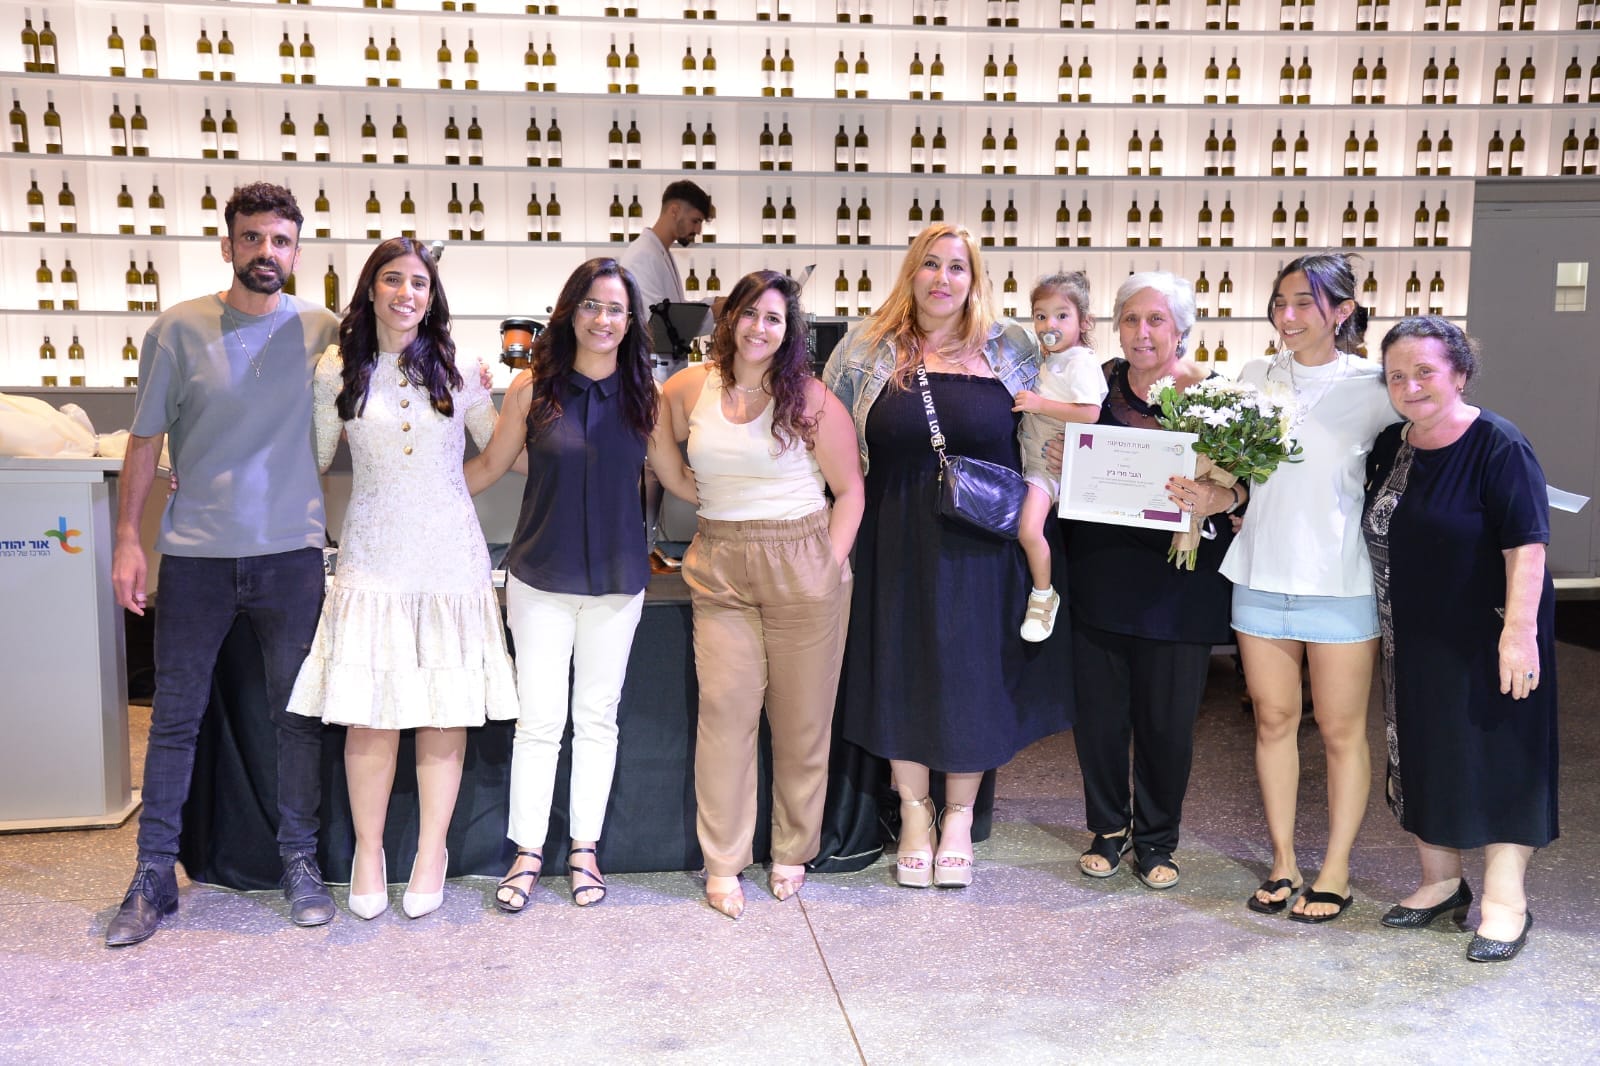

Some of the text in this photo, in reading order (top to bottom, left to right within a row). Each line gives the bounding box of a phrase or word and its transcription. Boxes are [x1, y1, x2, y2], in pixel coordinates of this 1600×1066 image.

[921, 391, 935, 416] LOVE
[929, 420, 942, 445] LOVE
[0, 540, 50, 549] אור יהוד
